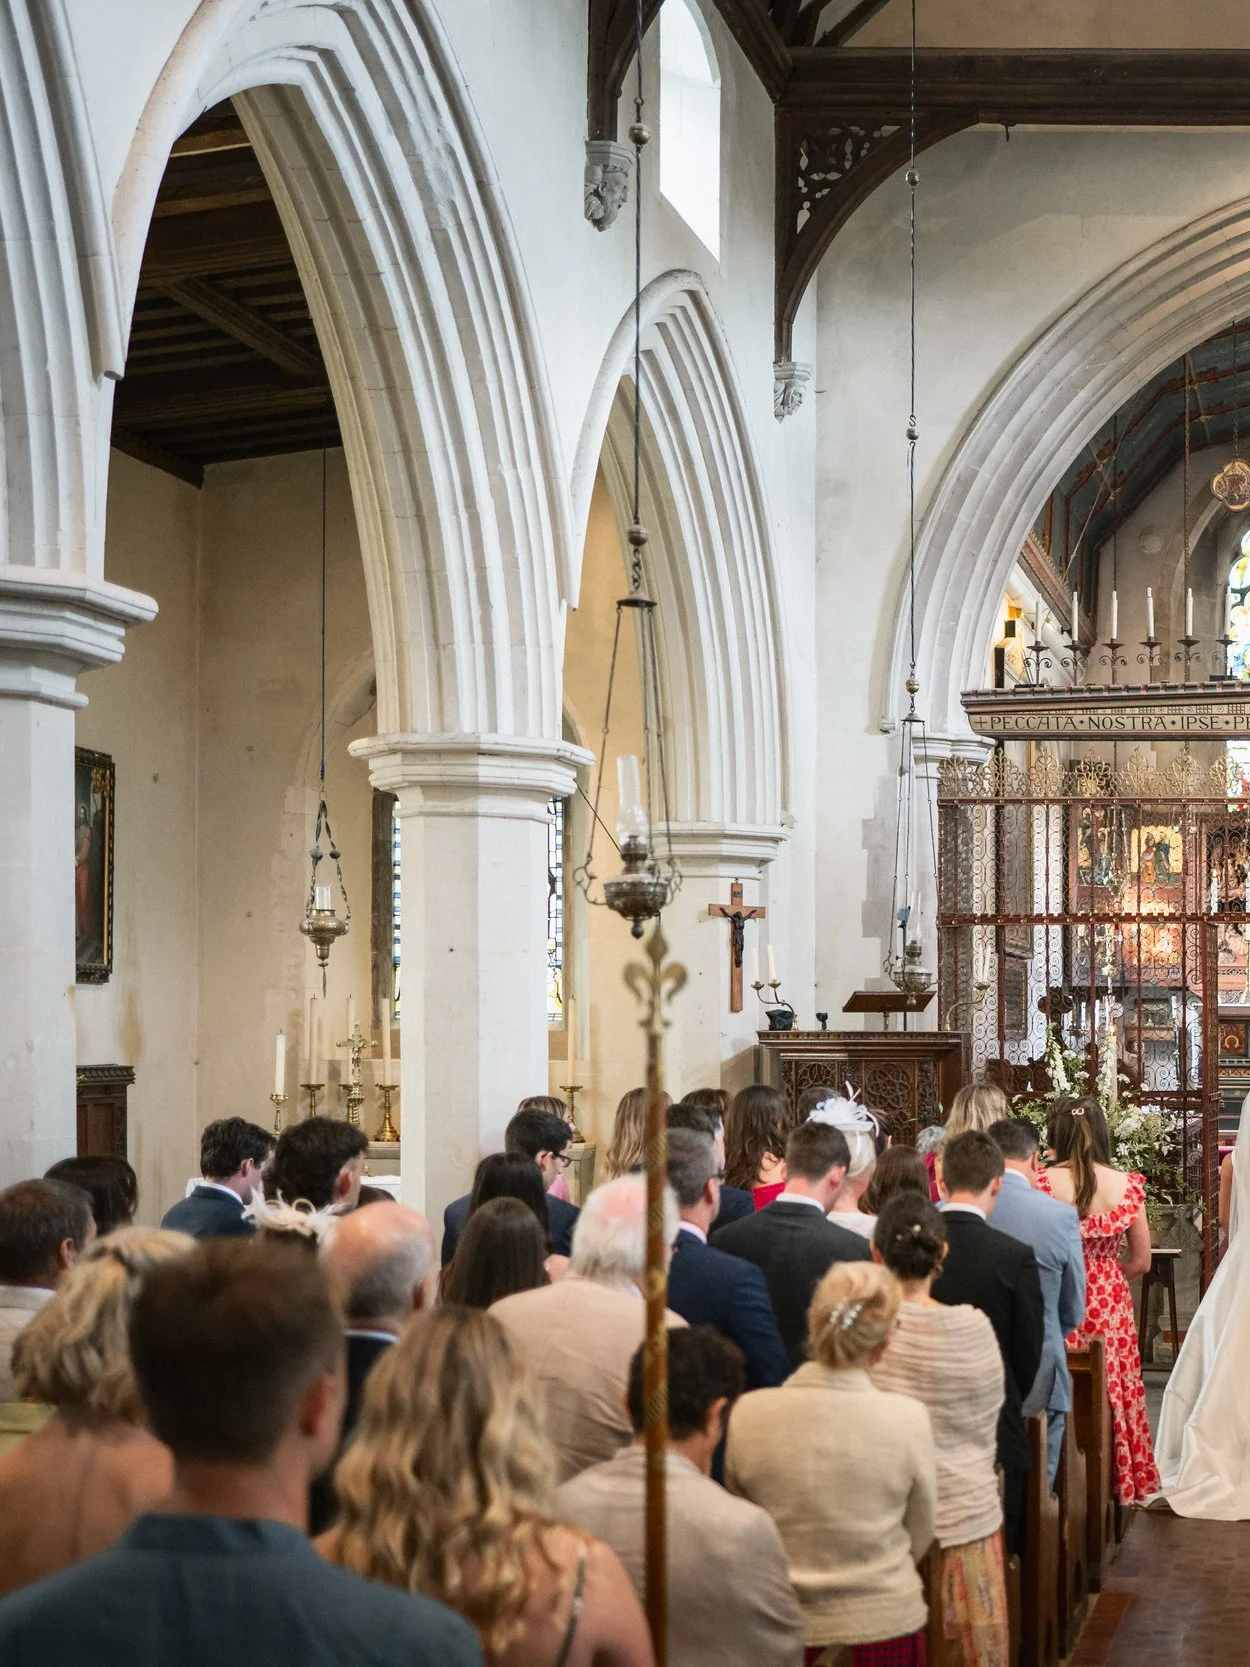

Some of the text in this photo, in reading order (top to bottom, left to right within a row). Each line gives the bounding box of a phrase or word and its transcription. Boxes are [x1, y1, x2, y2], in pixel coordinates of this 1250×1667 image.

[990, 716, 1078, 730] PECCATA
[1089, 716, 1168, 730] NOSTRA
[1181, 716, 1223, 730] IPSE
